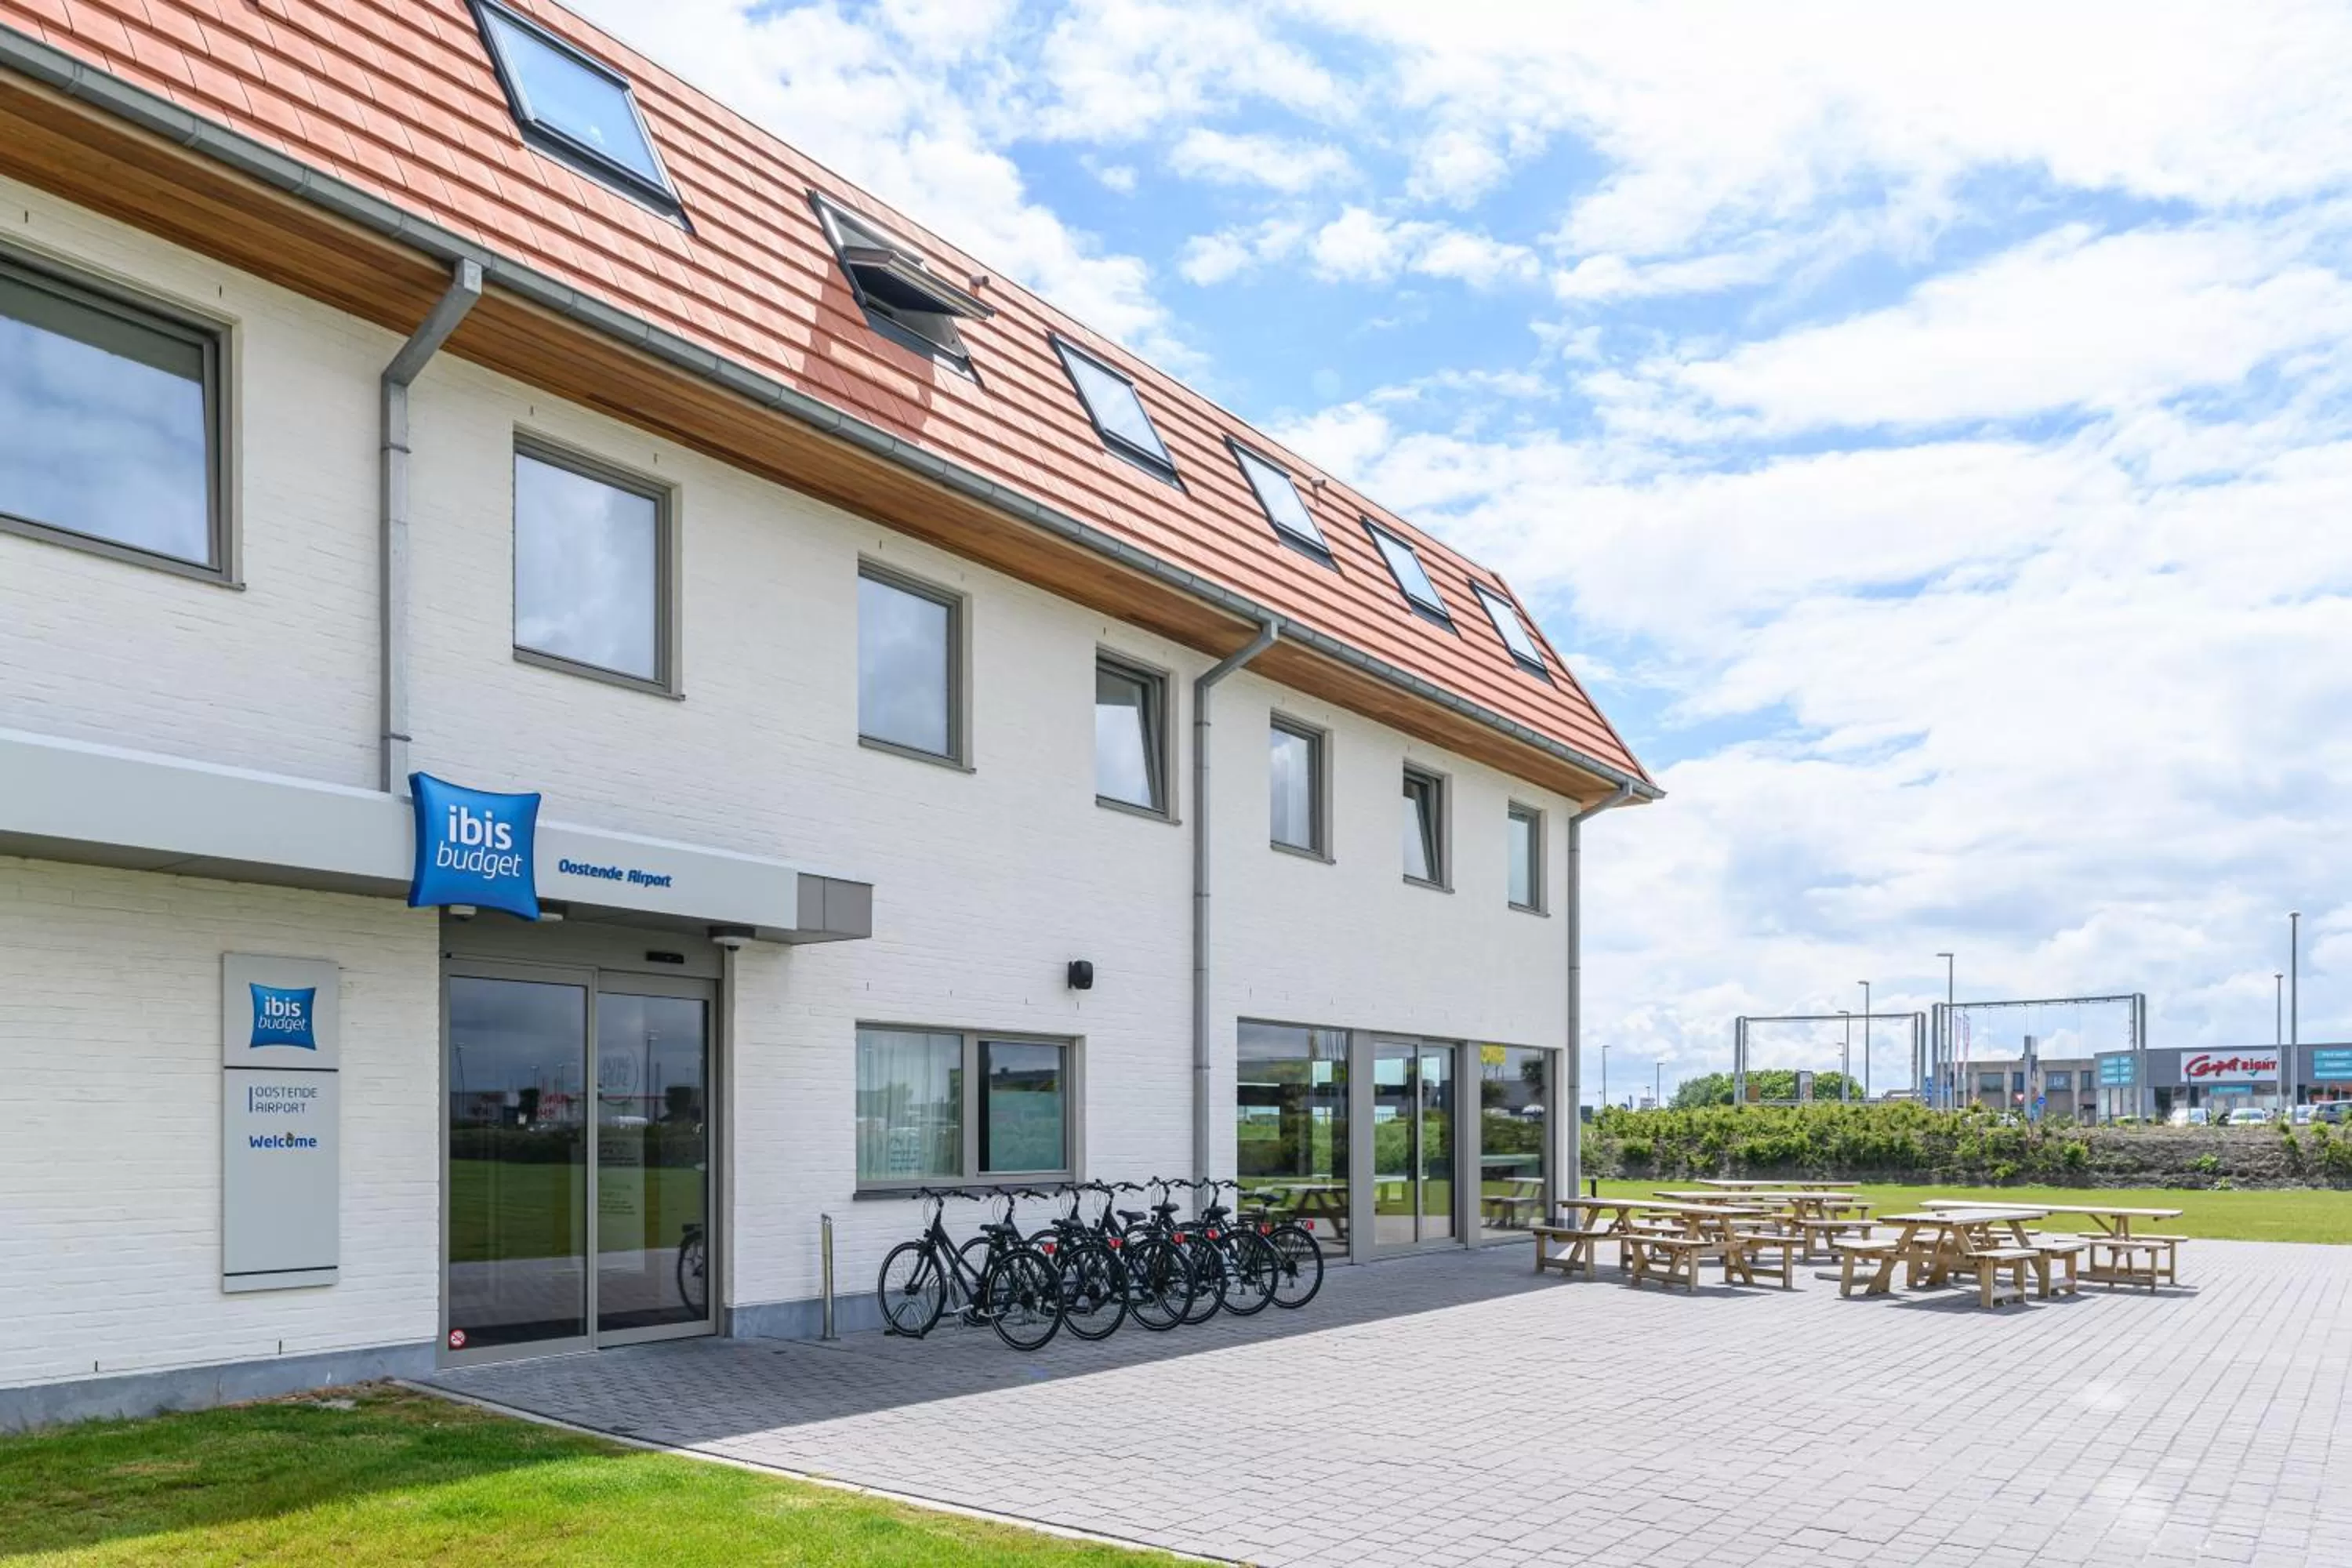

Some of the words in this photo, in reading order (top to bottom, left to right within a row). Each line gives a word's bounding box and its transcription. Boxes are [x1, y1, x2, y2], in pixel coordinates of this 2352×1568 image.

[448, 804, 513, 851] ibis
[436, 840, 523, 880] budget
[558, 858, 624, 880] Oostende
[626, 869, 673, 887] Airport
[264, 995, 302, 1018] ibis
[258, 1014, 308, 1033] budget
[255, 1101, 306, 1114] AIRPORT
[249, 1134, 318, 1149] Welcome
